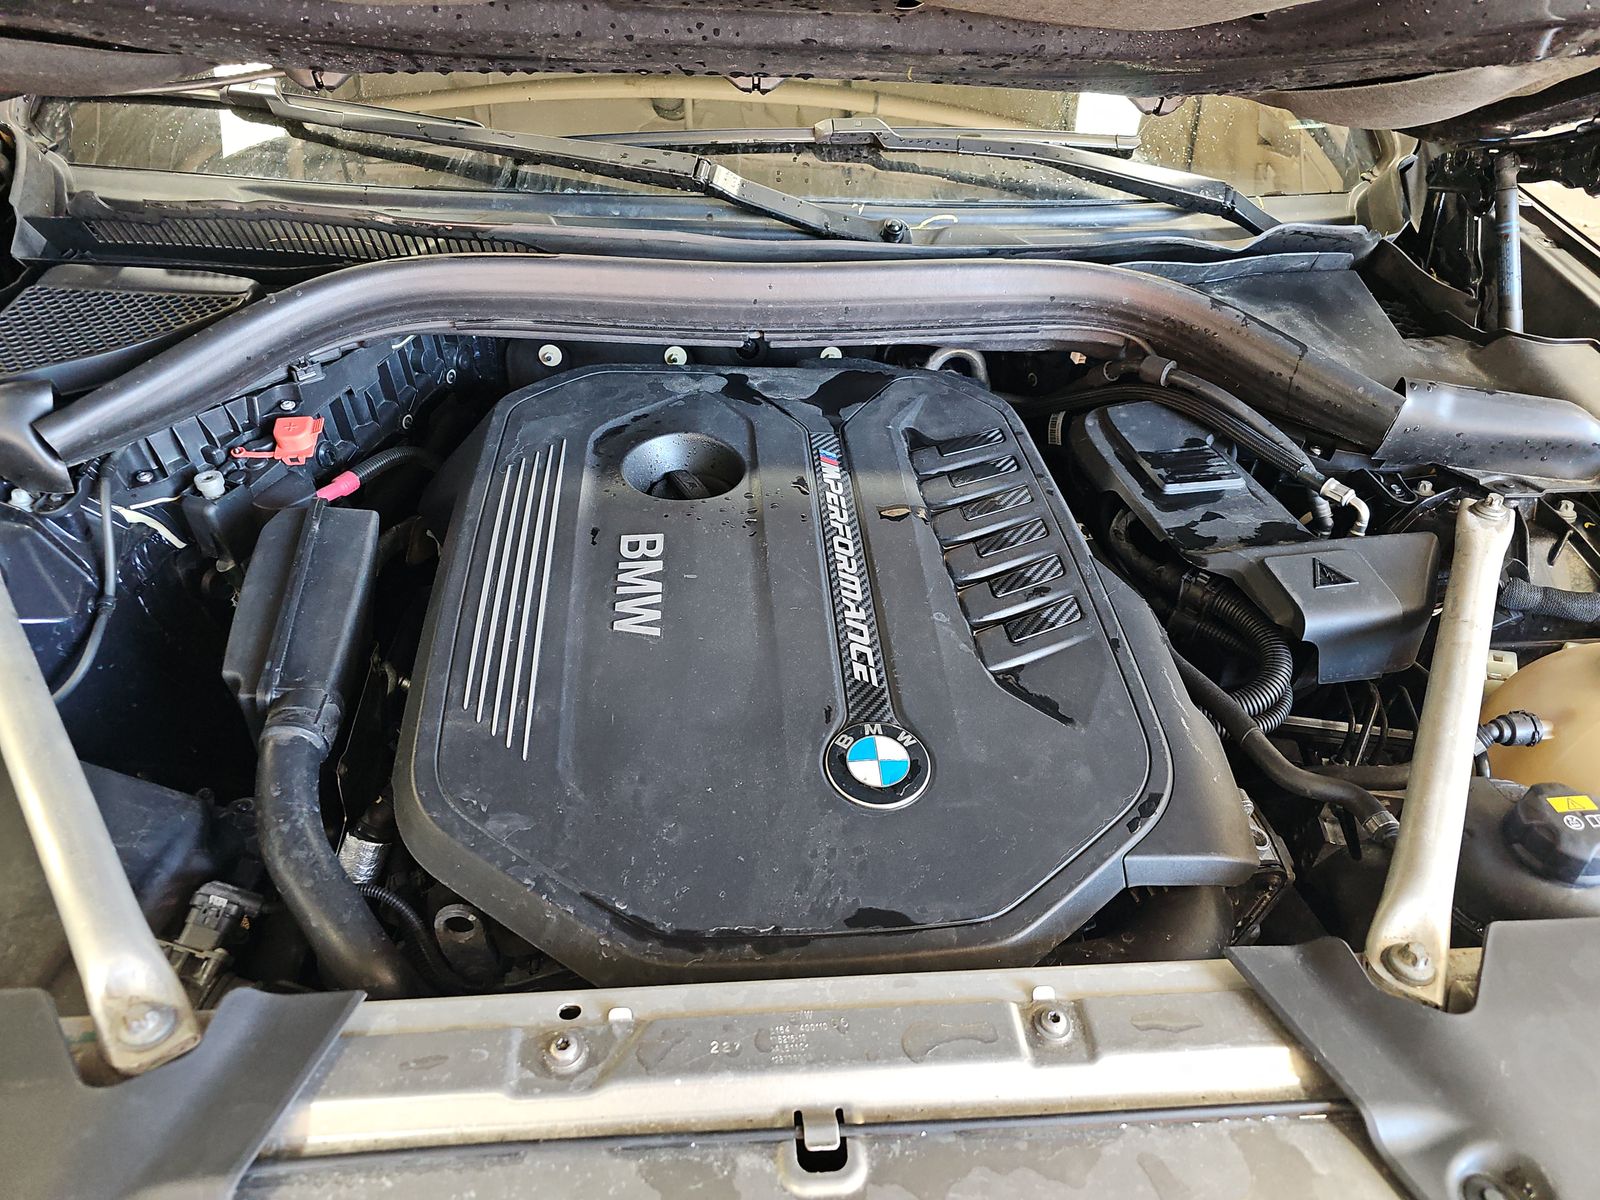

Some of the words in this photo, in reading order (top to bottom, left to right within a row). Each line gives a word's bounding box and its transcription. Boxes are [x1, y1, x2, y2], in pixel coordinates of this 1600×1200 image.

[613, 533, 664, 636] BMW
[824, 477, 879, 687] PERFORMANCE
[834, 723, 918, 750] BMW
